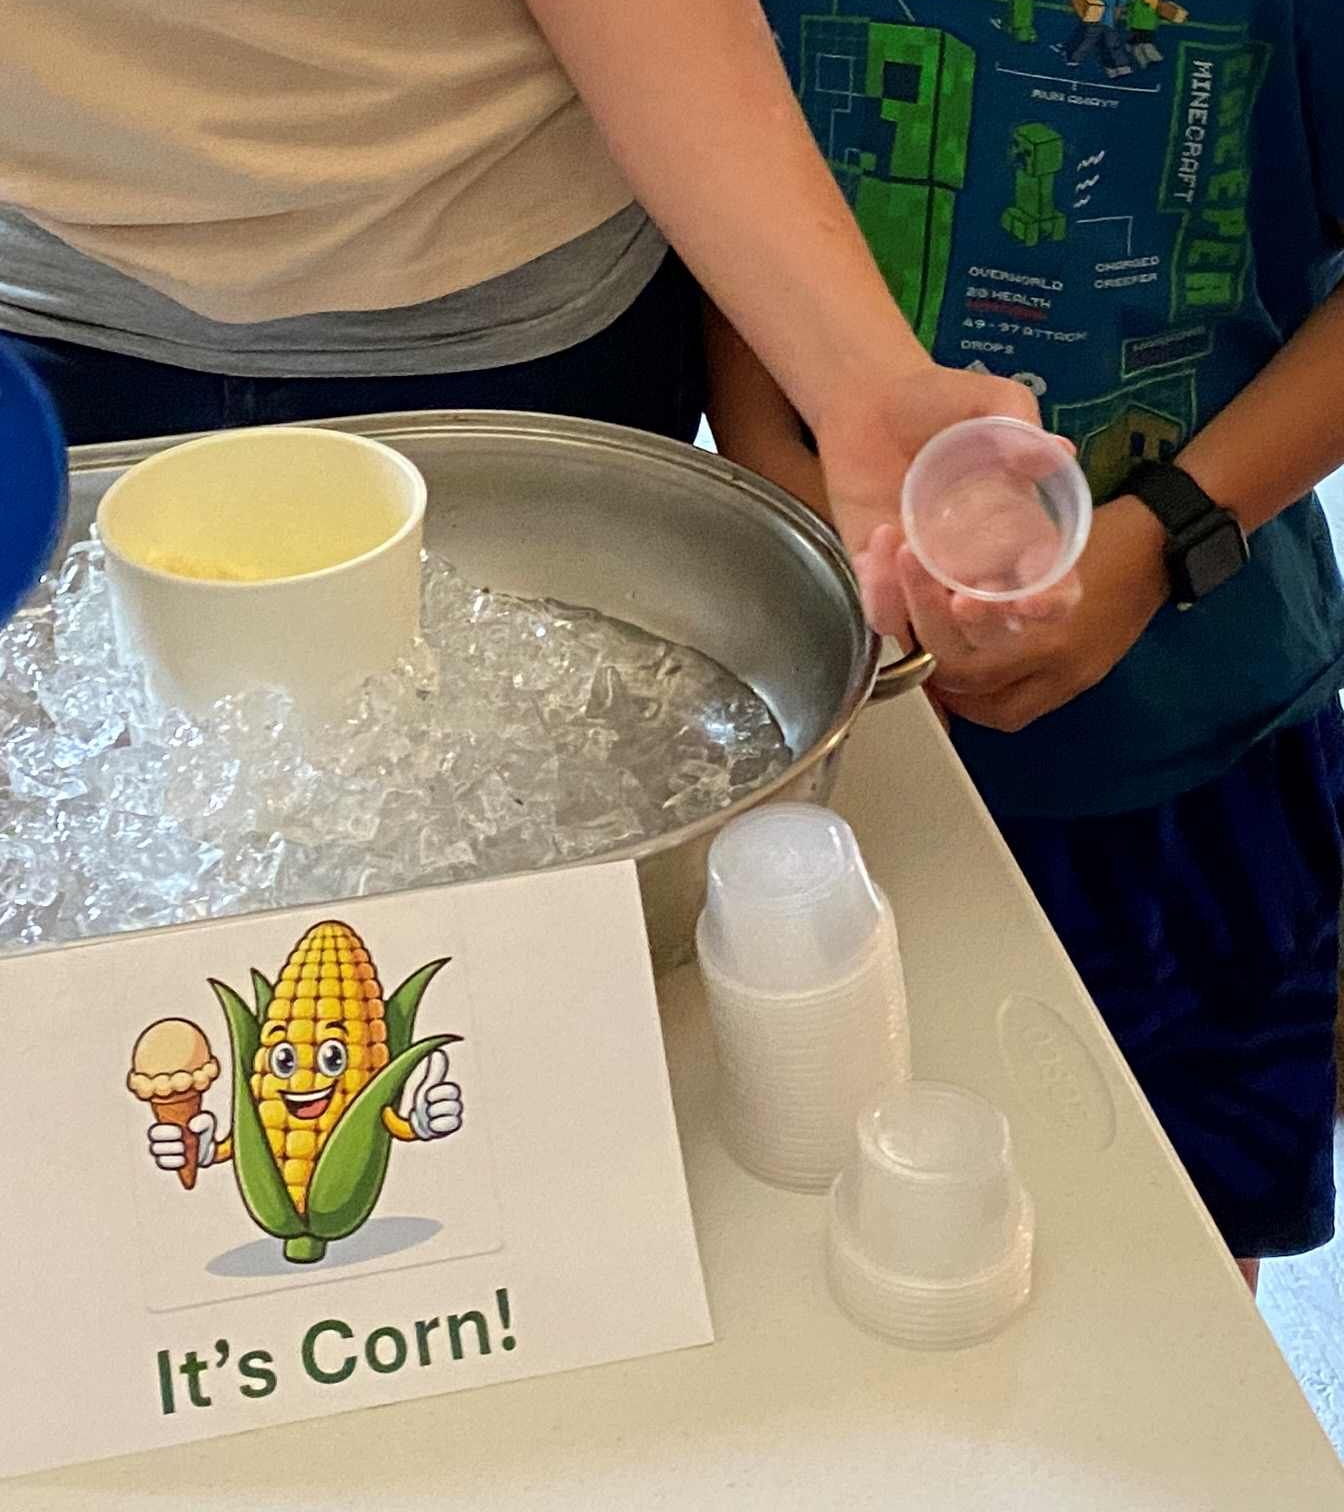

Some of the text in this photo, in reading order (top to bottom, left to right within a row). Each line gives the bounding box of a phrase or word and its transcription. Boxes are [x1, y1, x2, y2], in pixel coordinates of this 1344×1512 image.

[1173, 59, 1214, 204] MINECRAFT
[1185, 52, 1254, 306] CREEPER
[1095, 255, 1160, 272] CHARGED
[968, 266, 1064, 291] OVERWORLD
[991, 290, 1051, 309] HEALTH
[1022, 326, 1088, 343] ATTACK
[960, 339, 1015, 355] DROPS
[157, 1287, 517, 1415] It’s Corn!
